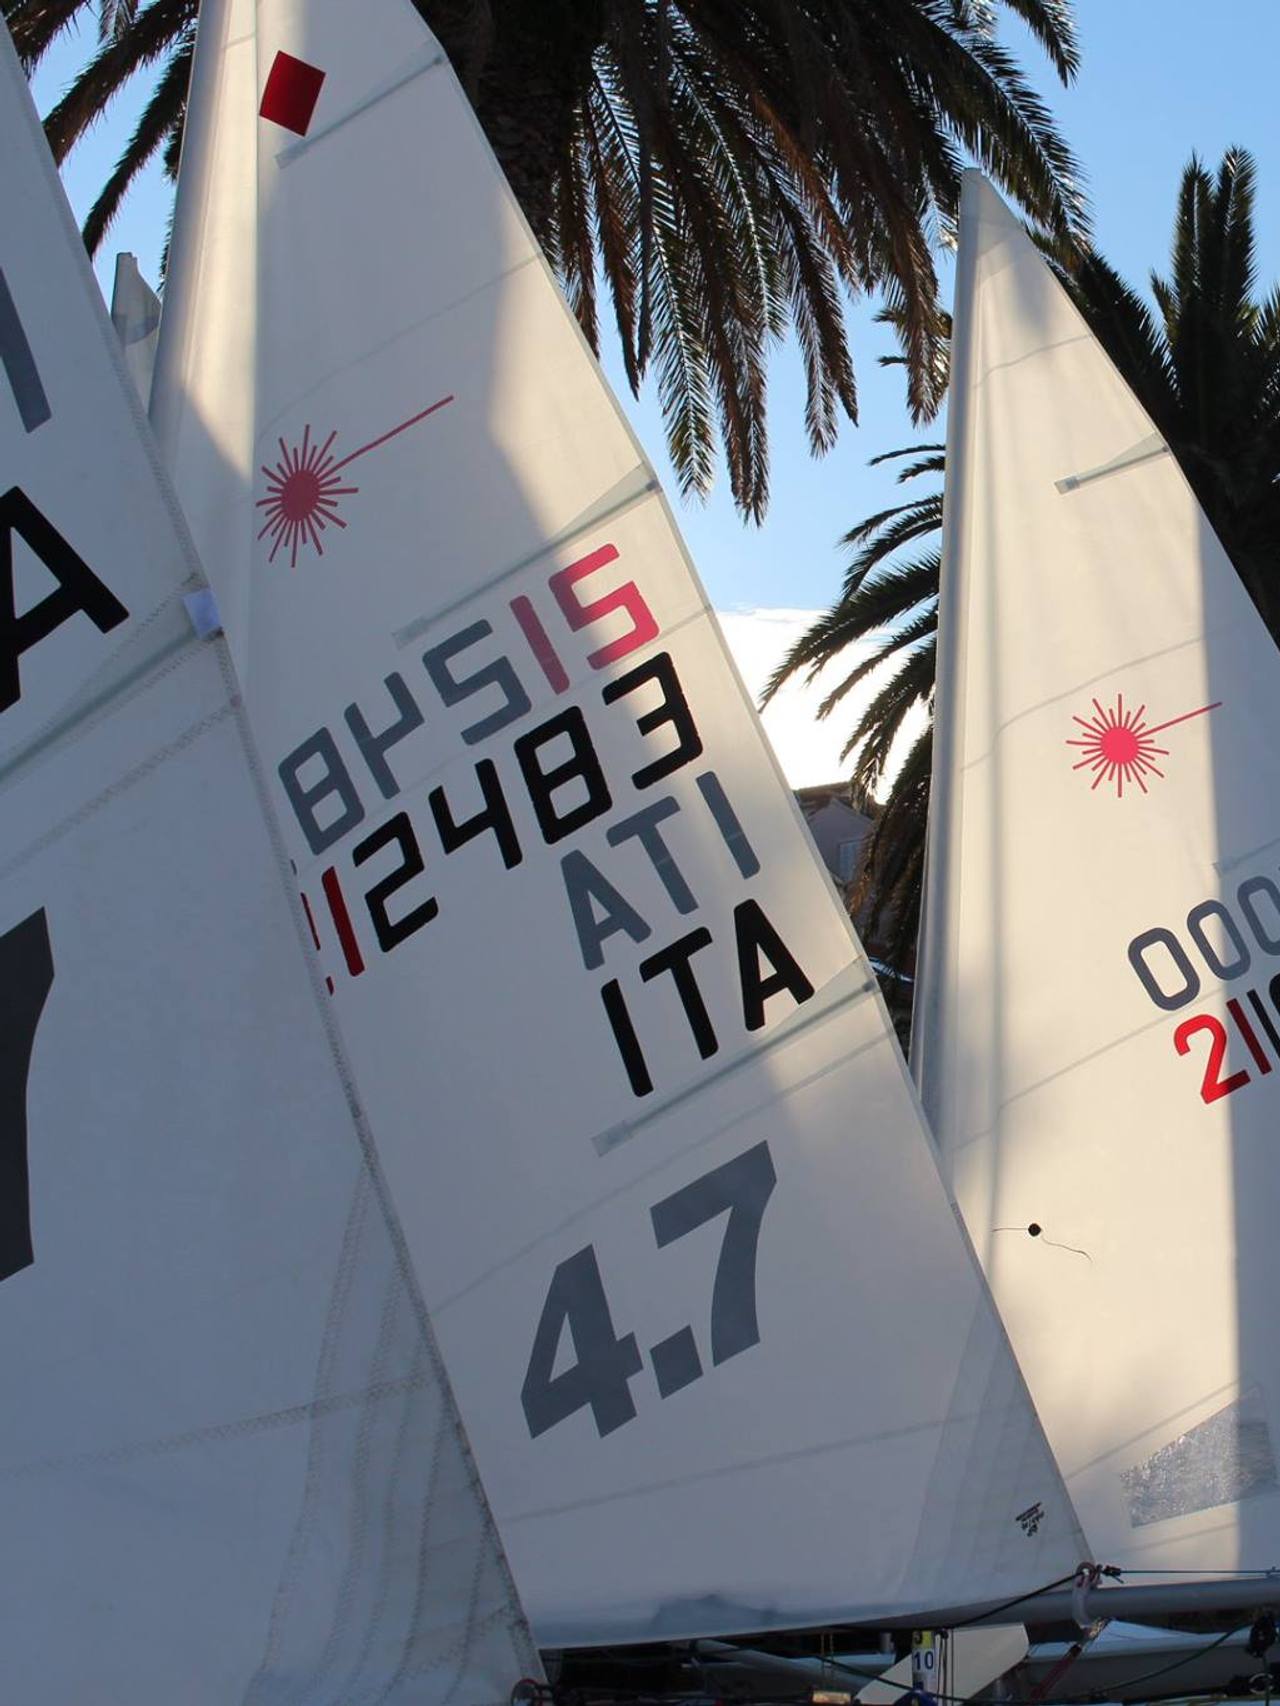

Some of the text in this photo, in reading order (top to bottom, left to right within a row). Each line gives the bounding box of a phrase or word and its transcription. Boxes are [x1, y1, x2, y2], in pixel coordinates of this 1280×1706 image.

[301, 652, 703, 996] 12483
[601, 898, 815, 1098] ITA
[520, 1140, 778, 1439] 4.7
